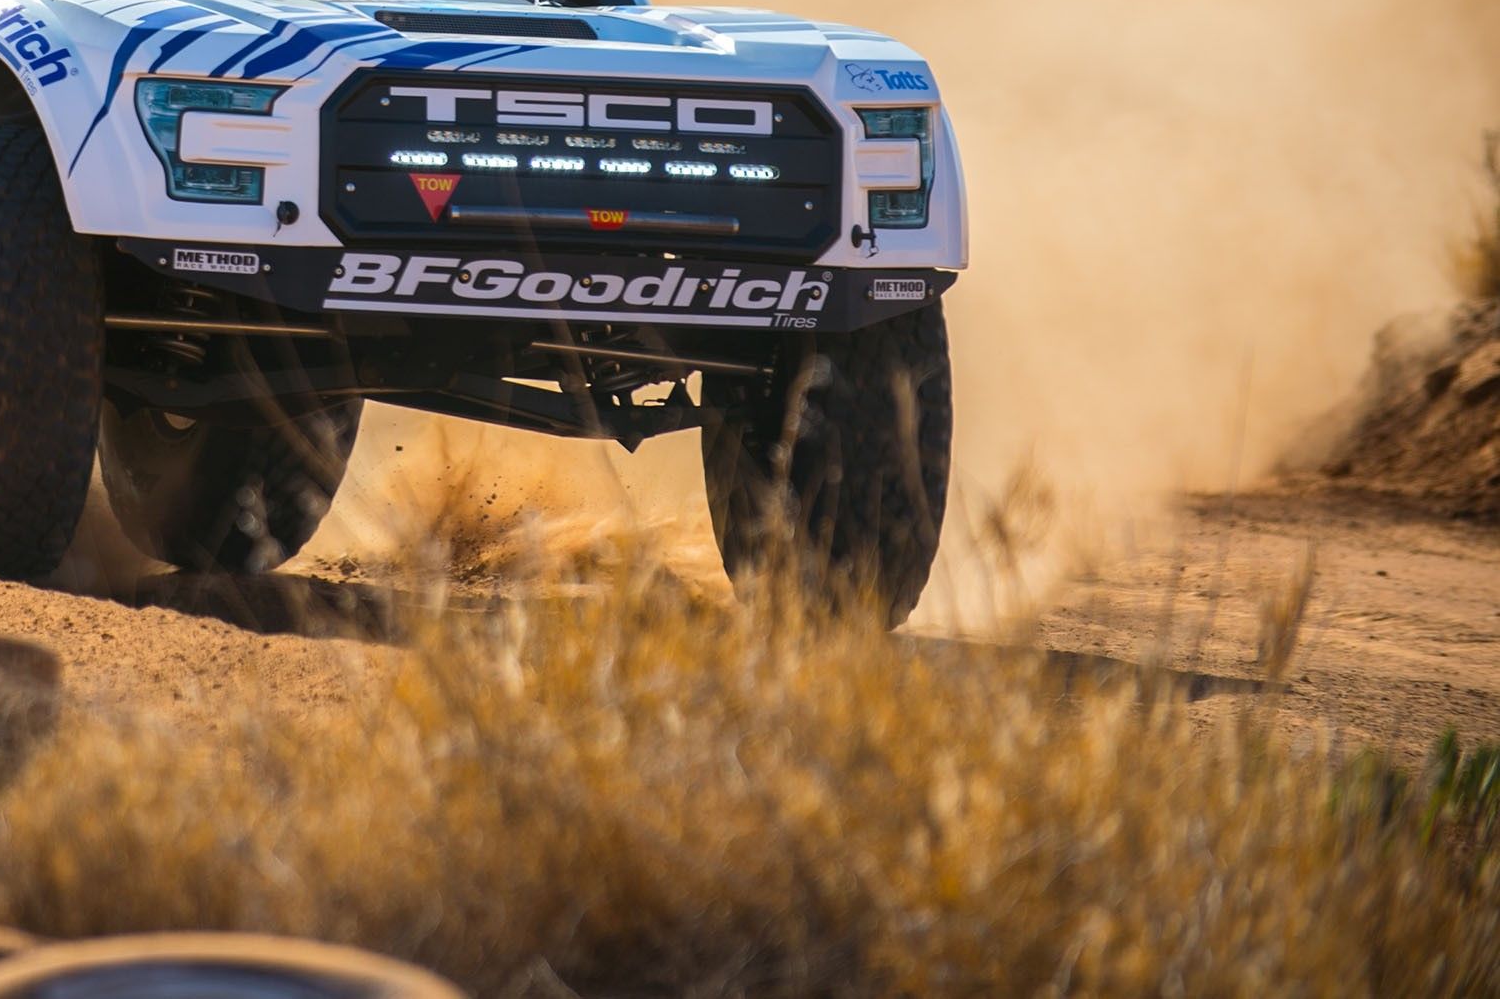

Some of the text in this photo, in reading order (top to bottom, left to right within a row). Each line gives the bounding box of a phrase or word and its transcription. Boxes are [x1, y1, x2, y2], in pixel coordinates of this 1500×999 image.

[21, 66, 38, 96] Tires
[874, 69, 929, 90] Tatts
[389, 86, 773, 135] TSCO
[418, 177, 453, 192] TOW
[590, 209, 625, 224] TOW
[176, 251, 256, 267] METHOD
[210, 264, 256, 273] WHEELS
[328, 253, 830, 312] BFGoodrich
[875, 281, 924, 292] METHOD
[772, 312, 818, 329] Tires
